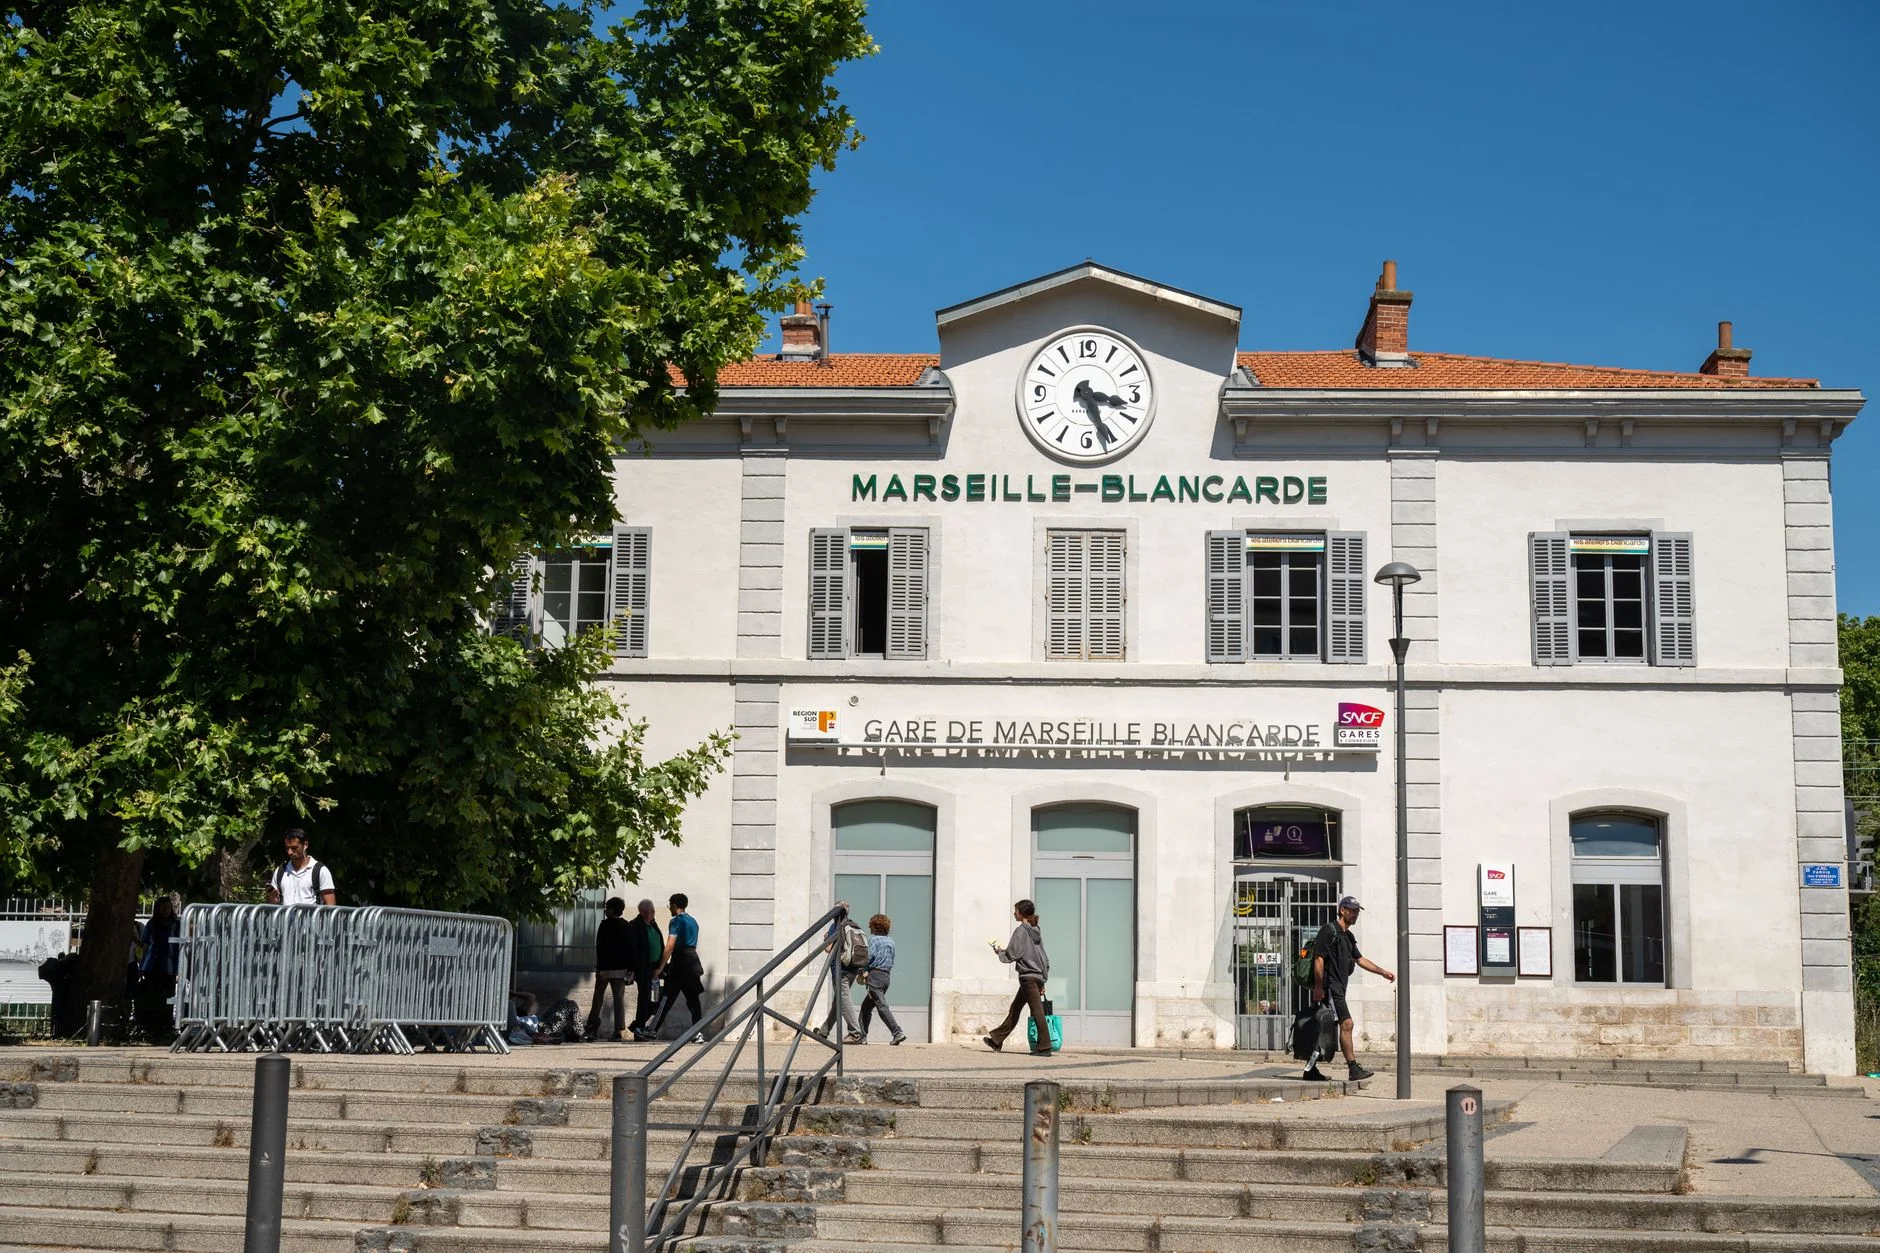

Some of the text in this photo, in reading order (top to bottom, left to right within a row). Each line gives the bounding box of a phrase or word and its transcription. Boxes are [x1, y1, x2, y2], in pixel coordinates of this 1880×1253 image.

[1079, 339, 1097, 358] 12
[1034, 384, 1047, 403] 9
[1128, 384, 1141, 403] 3
[1080, 431, 1093, 449] 6
[1340, 711, 1383, 724] SNCF
[864, 719, 1320, 747] GARE DE MARSEILLE BLANCARDE
[1339, 730, 1380, 739] GARES
